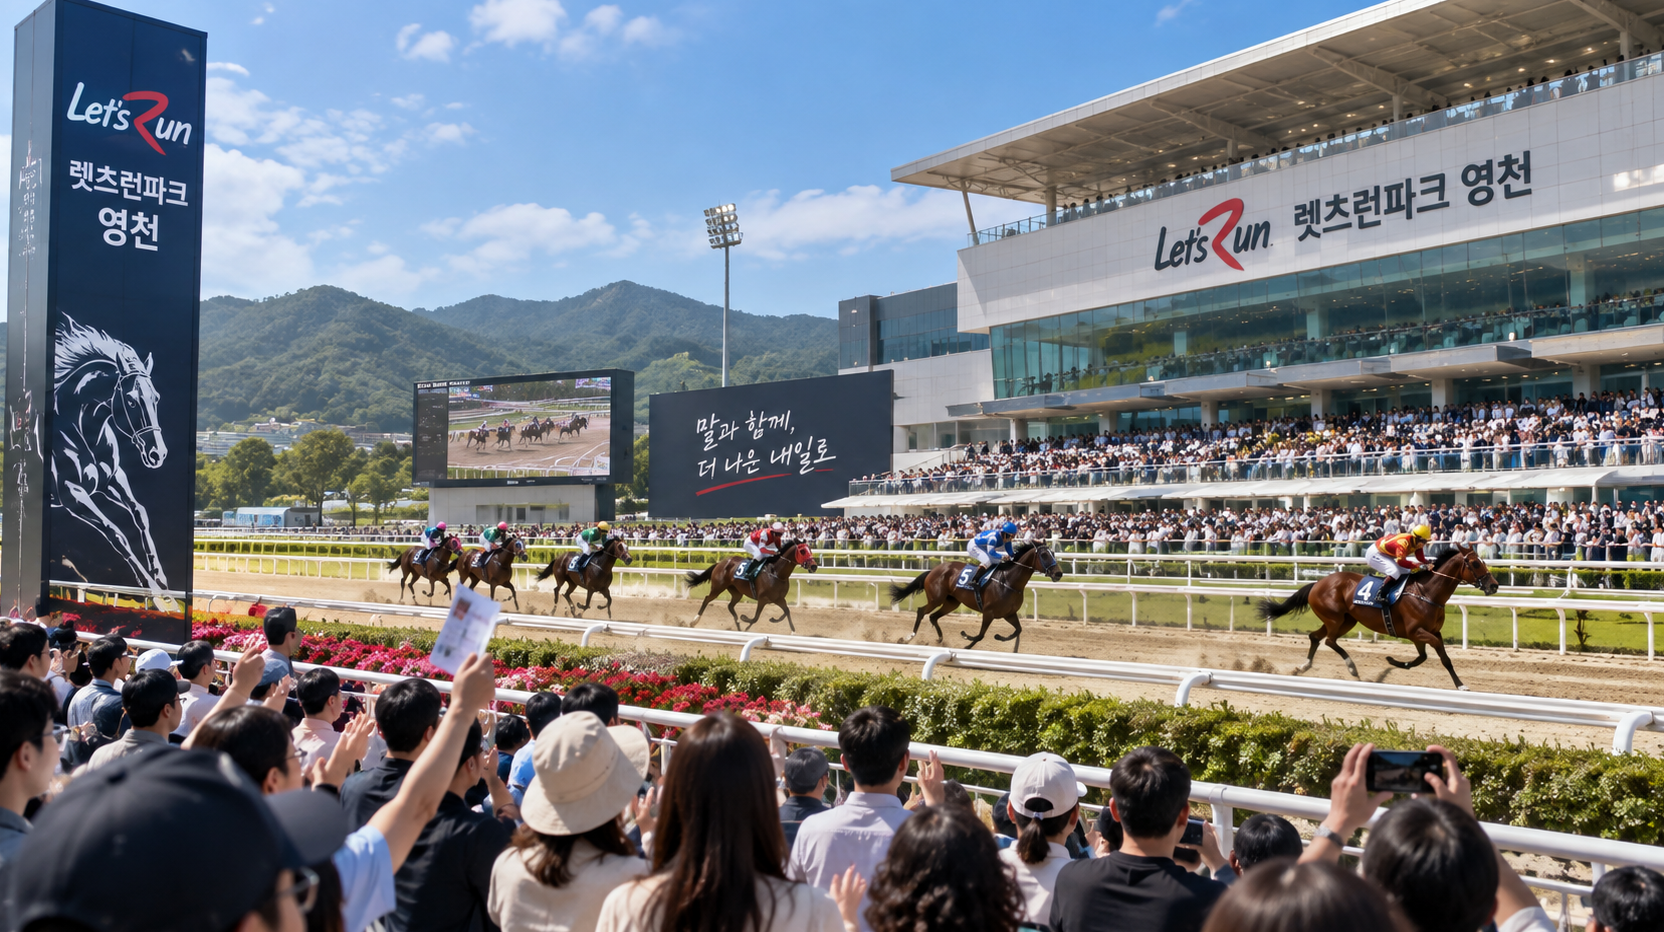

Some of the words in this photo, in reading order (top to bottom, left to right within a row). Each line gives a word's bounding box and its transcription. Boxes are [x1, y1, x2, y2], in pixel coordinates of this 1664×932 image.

[69, 160, 188, 207] 렛츠런파크
[1294, 174, 1450, 242] 렛츠런파크
[1461, 150, 1532, 206] 영천
[98, 207, 159, 252] 영천
[696, 413, 739, 451] 말과
[745, 410, 795, 439] 함께,
[698, 457, 717, 479] 더
[770, 435, 837, 475] 내일로
[736, 562, 747, 576] 5
[958, 568, 973, 585] 5
[1357, 581, 1374, 601] 4
